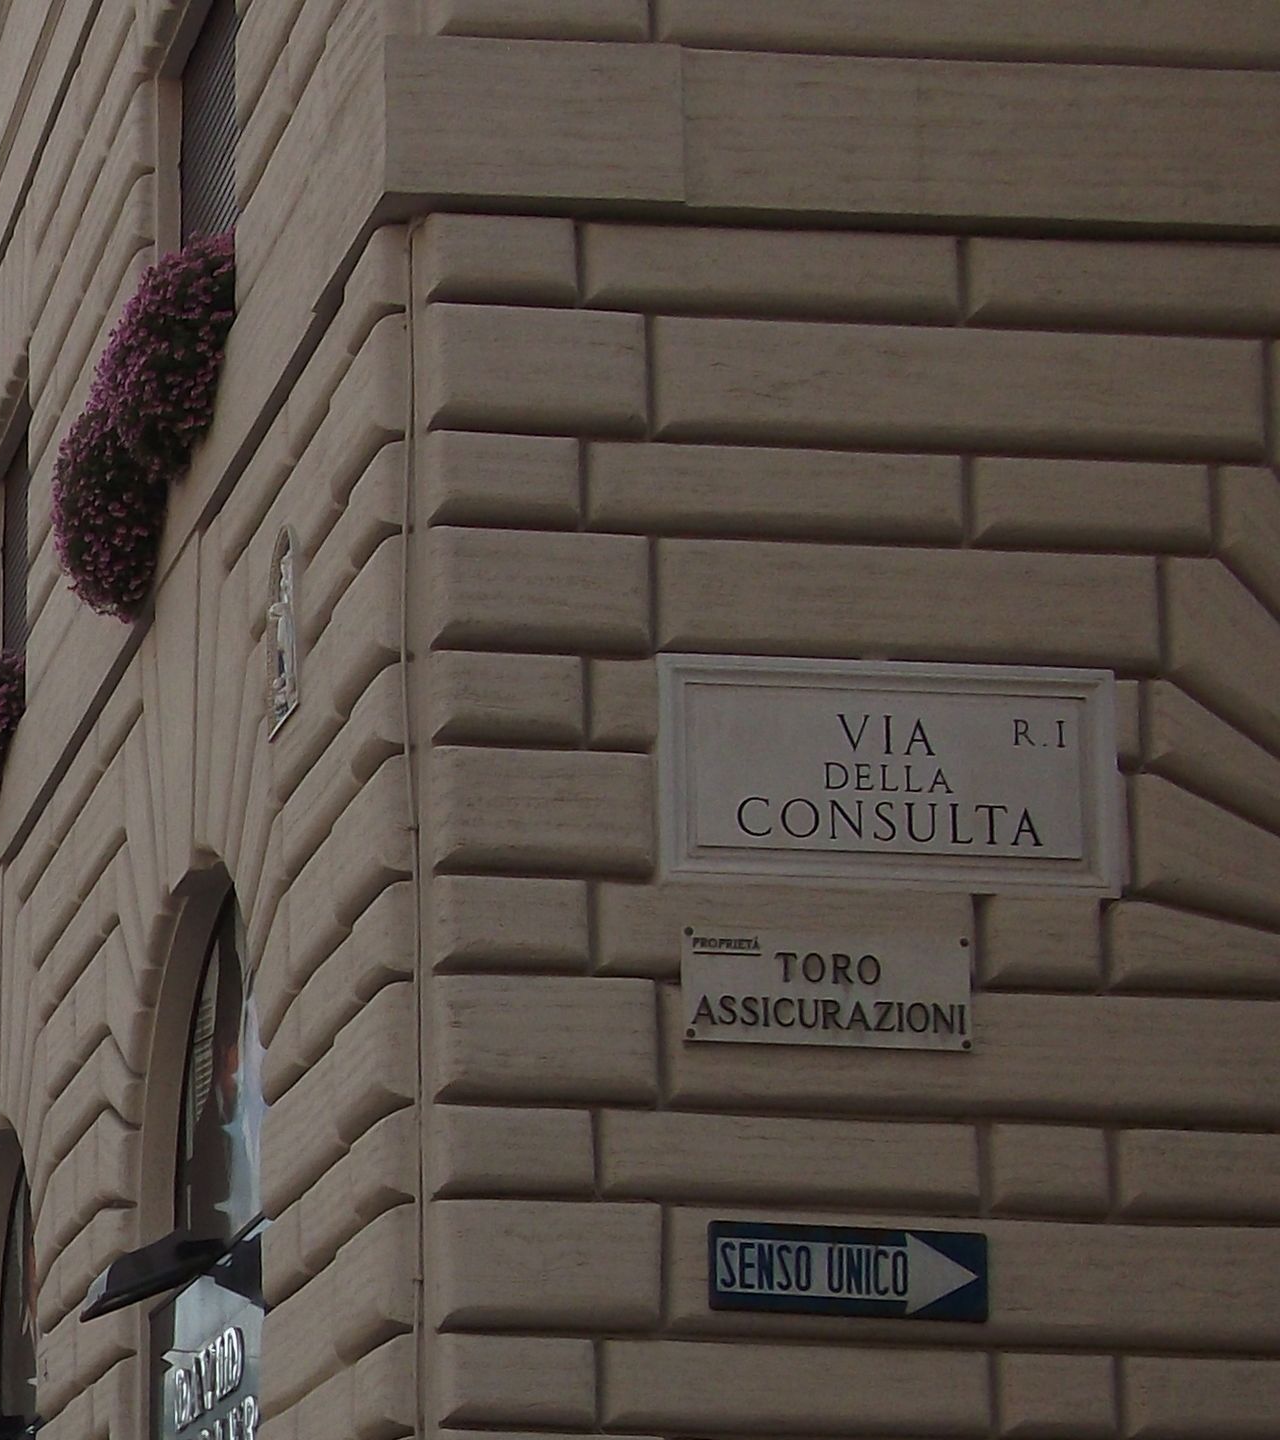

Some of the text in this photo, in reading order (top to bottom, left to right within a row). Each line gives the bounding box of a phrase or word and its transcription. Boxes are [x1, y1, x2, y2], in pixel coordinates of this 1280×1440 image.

[836, 713, 936, 757] VIA
[824, 762, 954, 795] DELLA
[736, 797, 1044, 847] CONSULTA
[774, 952, 882, 986] TORO
[691, 995, 968, 1035] ASSICURAZIONI
[719, 1240, 909, 1296] SENSO UNICO
[174, 1326, 244, 1433] DAVID
